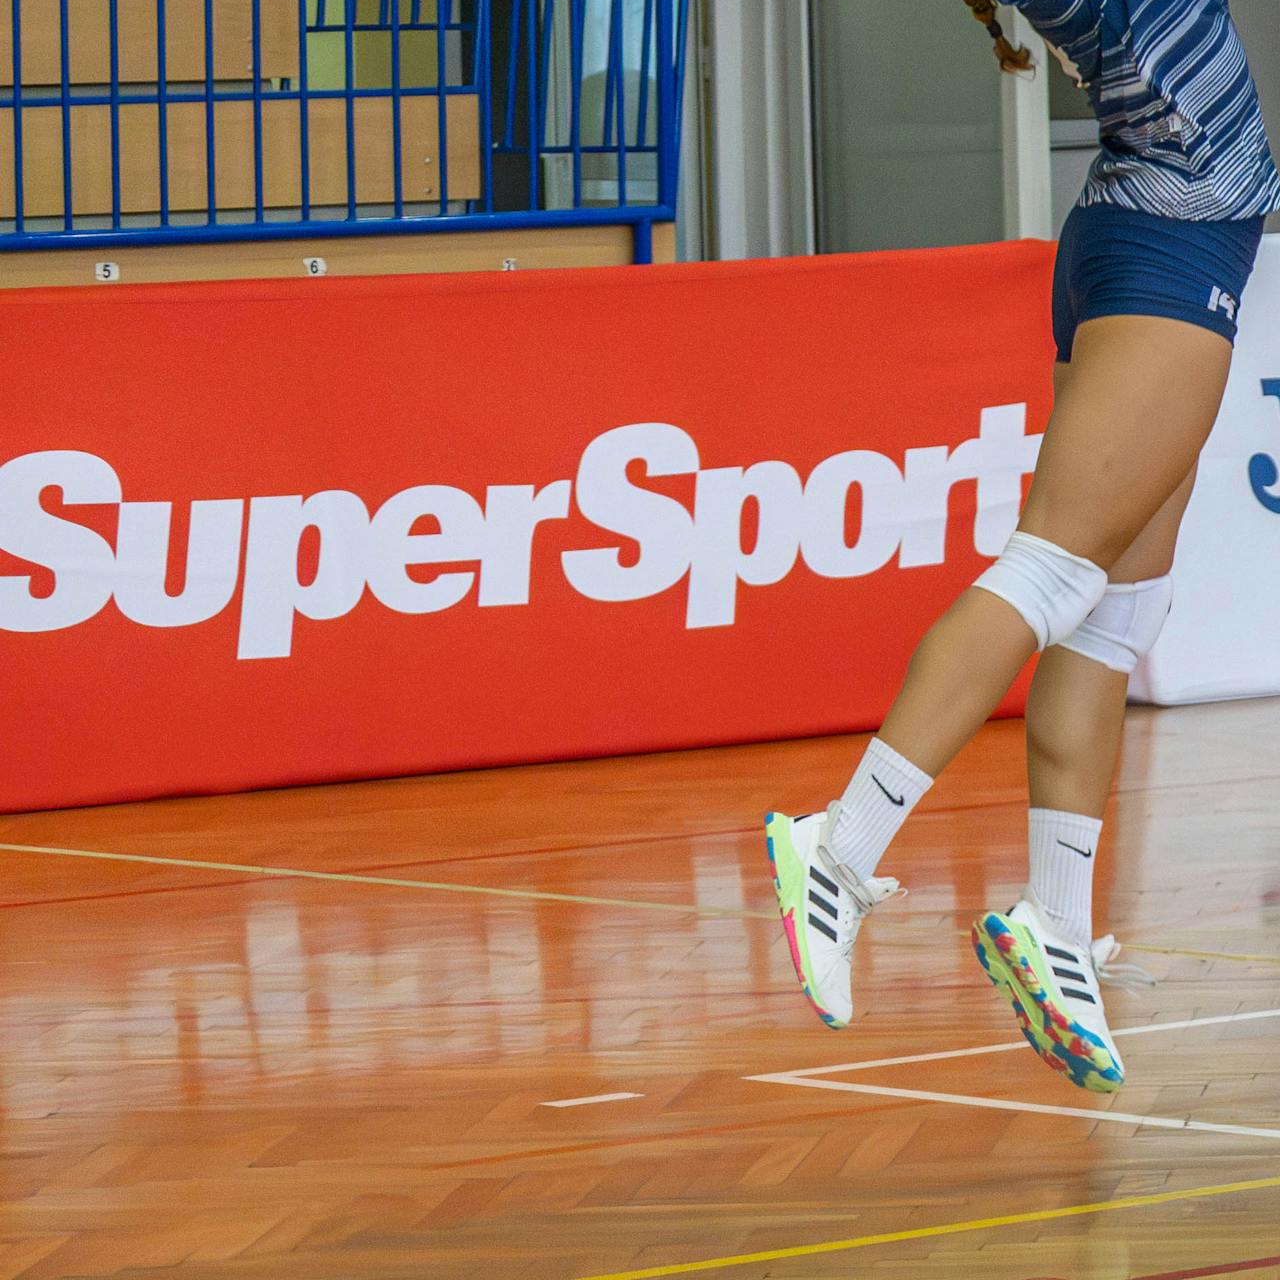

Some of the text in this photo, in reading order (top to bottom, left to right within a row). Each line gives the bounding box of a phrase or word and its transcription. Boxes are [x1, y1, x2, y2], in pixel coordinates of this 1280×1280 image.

[102, 264, 112, 278] 5
[309, 260, 319, 274] 6
[0, 402, 1045, 661] SuperSport
